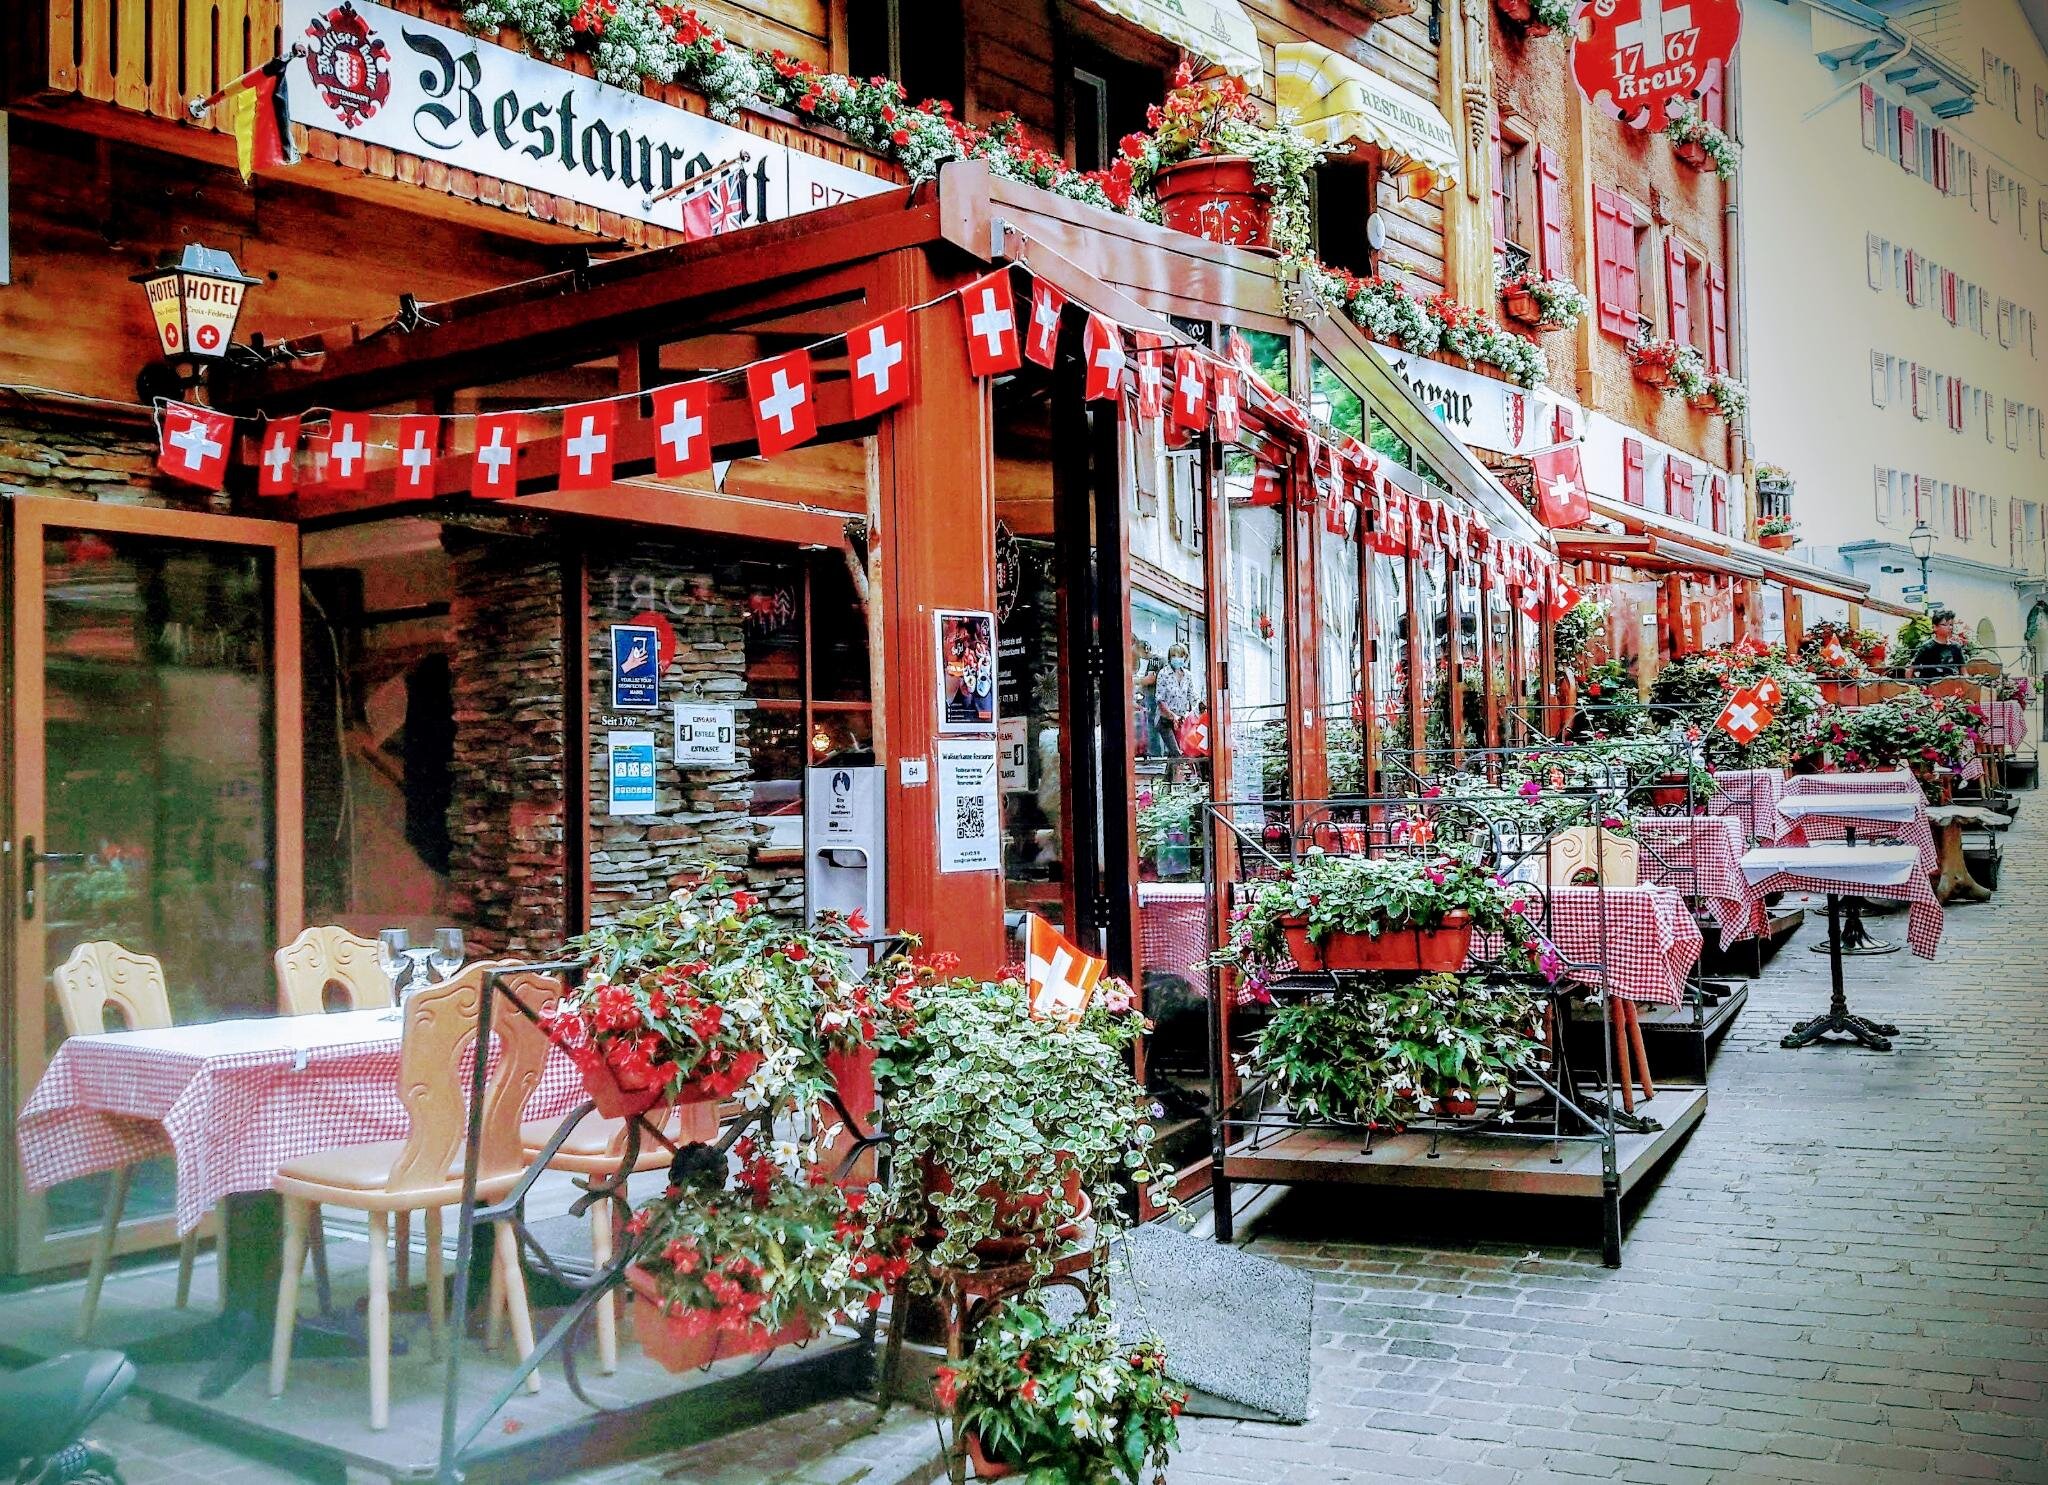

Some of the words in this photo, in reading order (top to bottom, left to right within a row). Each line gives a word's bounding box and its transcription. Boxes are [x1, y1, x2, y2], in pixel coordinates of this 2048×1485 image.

[1360, 87, 1453, 148] RESTAURANT
[811, 183, 860, 207] PIZ
[149, 279, 181, 303] HOTEL
[187, 280, 238, 306] HOTEL
[601, 715, 617, 727] Seit
[618, 716, 637, 727] 1767
[908, 767, 918, 776] 64
